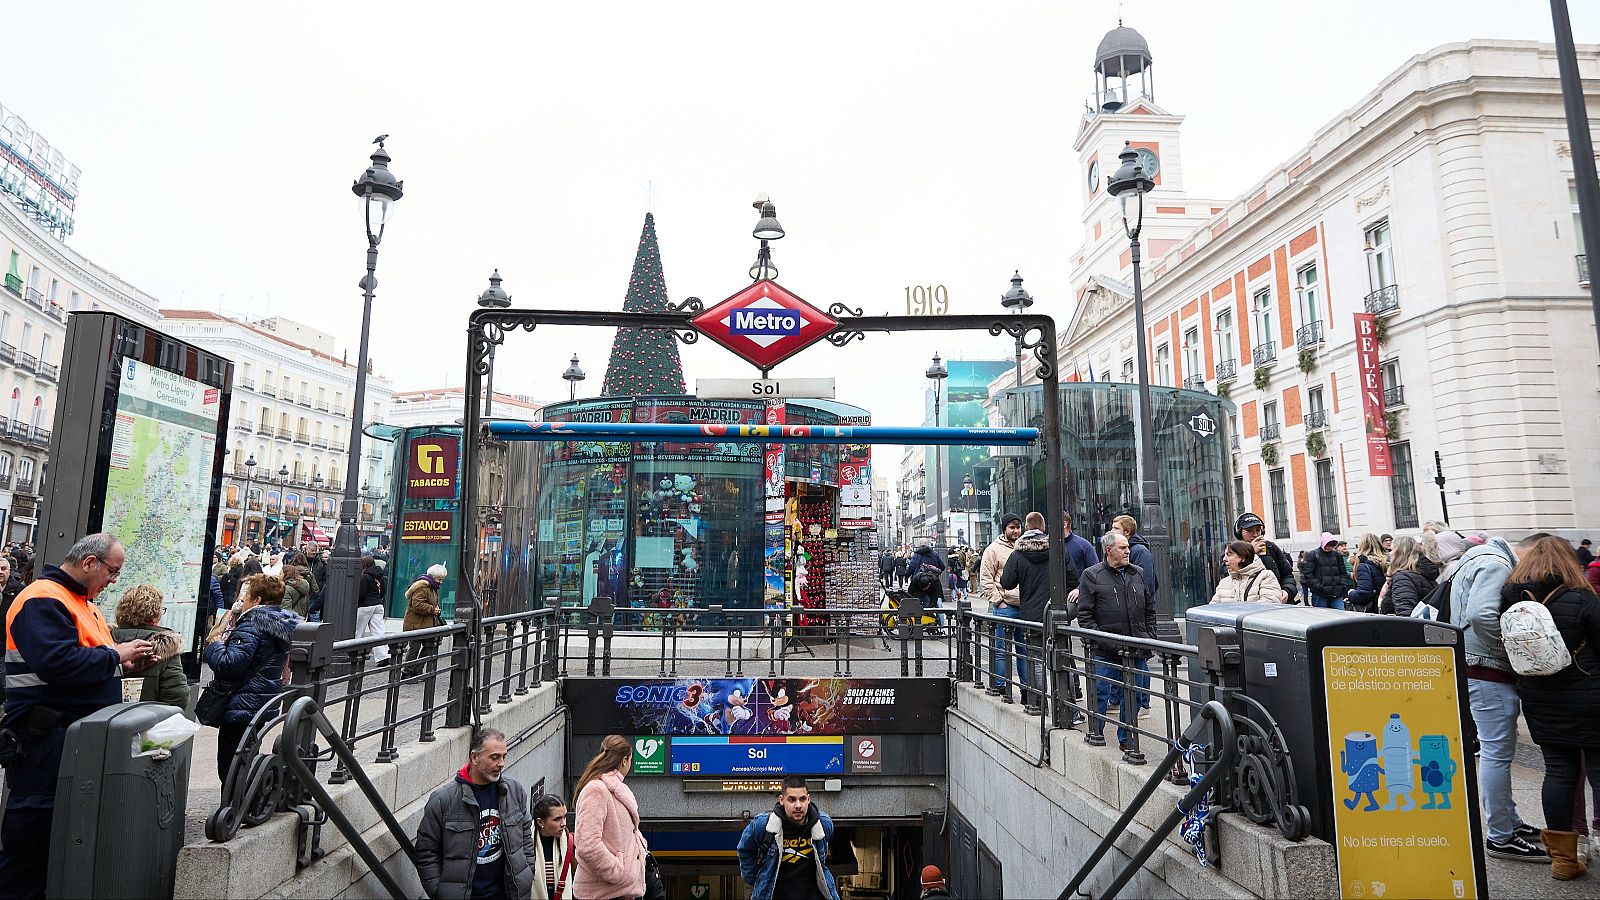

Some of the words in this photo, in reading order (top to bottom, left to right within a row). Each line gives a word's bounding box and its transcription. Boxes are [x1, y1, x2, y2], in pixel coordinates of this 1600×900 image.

[904, 285, 948, 315] 1919
[736, 312, 796, 330] Metro
[1360, 319, 1380, 407] BELÉN
[150, 377, 170, 390] Metro
[170, 382, 190, 397] Ligero
[752, 382, 780, 395] Sol
[572, 410, 612, 422] MADRID
[689, 407, 741, 422] MADRID
[1198, 418, 1210, 431] SOL
[410, 478, 450, 487] TABACOS
[404, 521, 449, 531] ESTANCO
[1329, 652, 1378, 665] Deposita
[1380, 652, 1415, 664] dentro
[1417, 653, 1444, 665] latas,
[1330, 665, 1356, 677] briks
[1358, 667, 1365, 679] y
[1367, 667, 1395, 677] otros
[1397, 667, 1441, 677] envases
[1332, 679, 1346, 690] de
[1348, 678, 1390, 692] plástico
[1393, 681, 1401, 690] o
[1403, 679, 1434, 690] metal.
[616, 685, 688, 703] SONIC
[683, 684, 704, 708] 3
[847, 688, 864, 697] SOLO
[865, 688, 874, 697] EN
[875, 688, 895, 698] CINES
[842, 697, 853, 706] 25
[854, 697, 896, 706] DICIEMBRE
[748, 748, 767, 759] Sol
[1343, 836, 1359, 847] No
[1361, 835, 1377, 847] los
[1380, 835, 1403, 847] tires
[1405, 835, 1414, 847] al
[1417, 835, 1450, 847] suelo.
